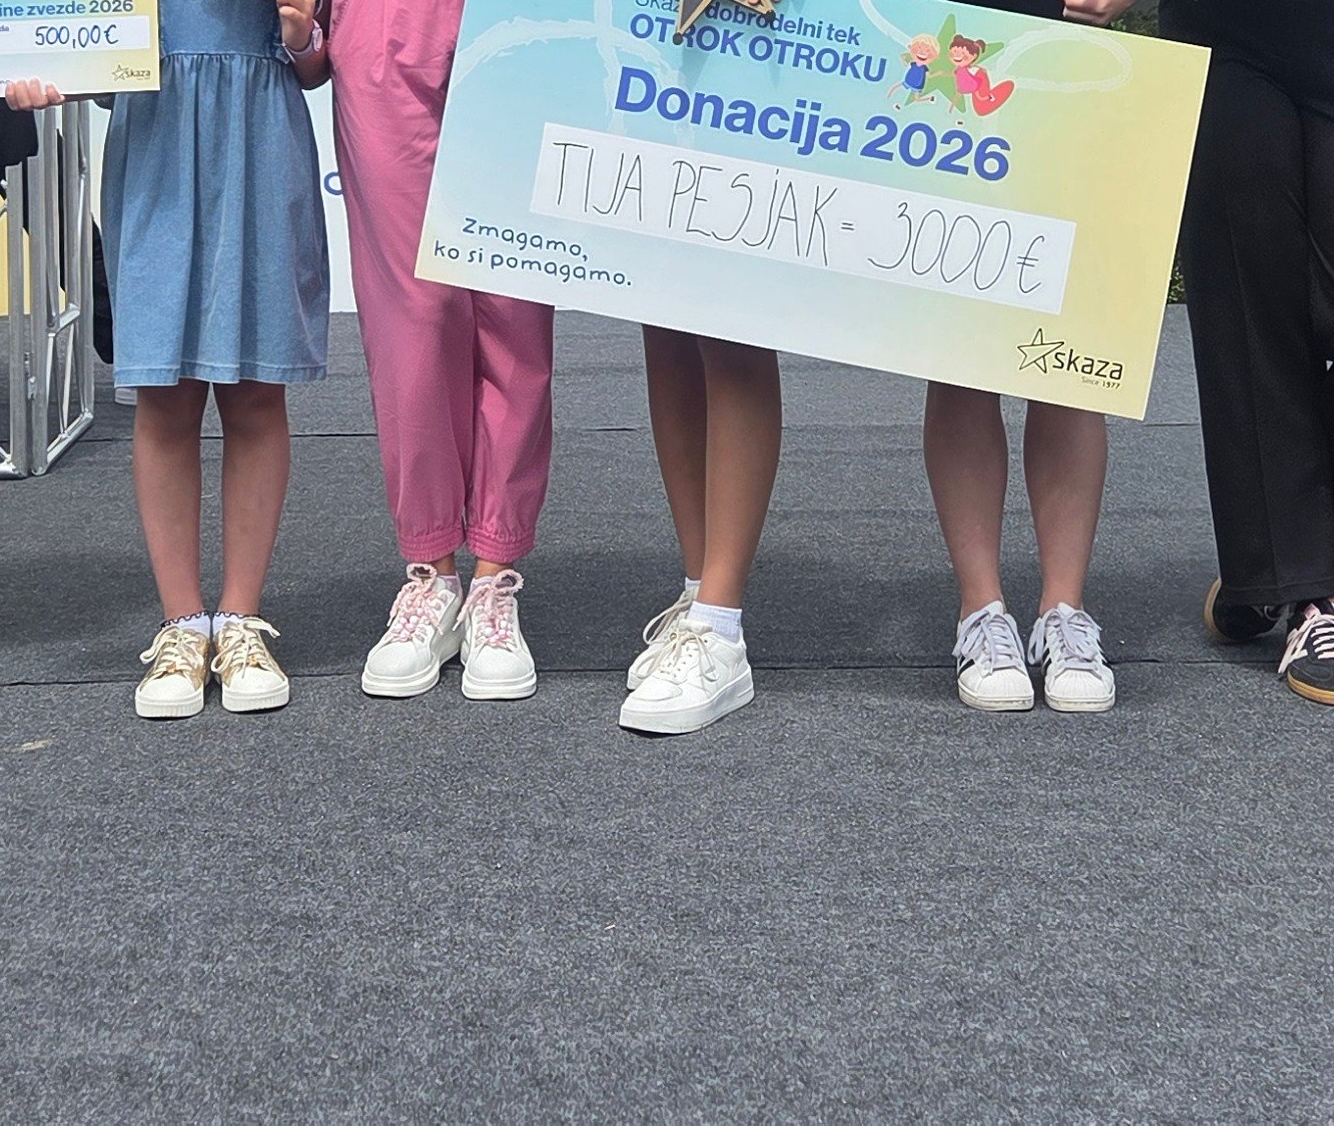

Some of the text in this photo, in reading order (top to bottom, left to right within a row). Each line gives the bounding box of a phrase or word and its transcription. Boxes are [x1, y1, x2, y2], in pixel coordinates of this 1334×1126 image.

[27, 1, 86, 15] zvezde
[89, 0, 134, 13] 2026
[705, 1, 824, 40] dobrodelni
[826, 25, 861, 46] tek
[748, 35, 887, 83] OTROKU
[615, 66, 1011, 182] Donacija 2026
[553, 142, 644, 222] TIJA
[462, 217, 588, 262] Zmagamo,
[434, 240, 632, 286] ko si pomagamo.
[1052, 348, 1124, 380] skaza
[1102, 381, 1121, 389] 1977
